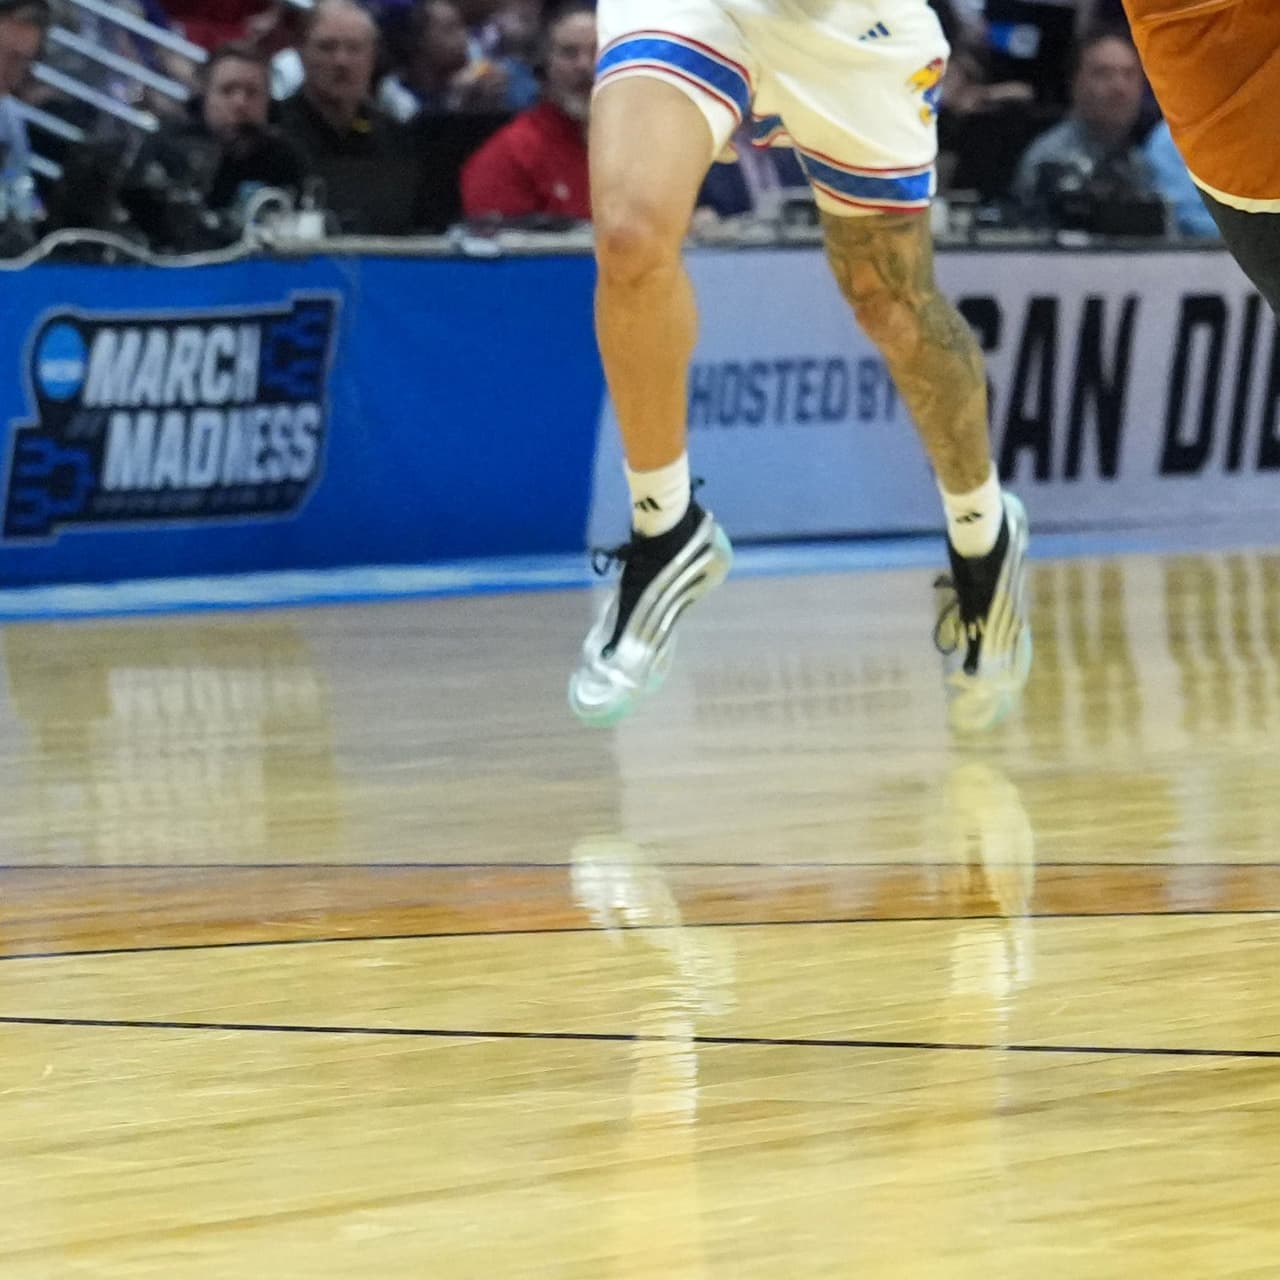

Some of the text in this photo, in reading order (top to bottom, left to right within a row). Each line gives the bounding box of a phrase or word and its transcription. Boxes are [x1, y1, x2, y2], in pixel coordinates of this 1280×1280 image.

[83, 322, 262, 408] MARCH
[688, 357, 849, 430] HOSTED
[957, 294, 1141, 482] AN
[102, 402, 322, 491] MADNESS
